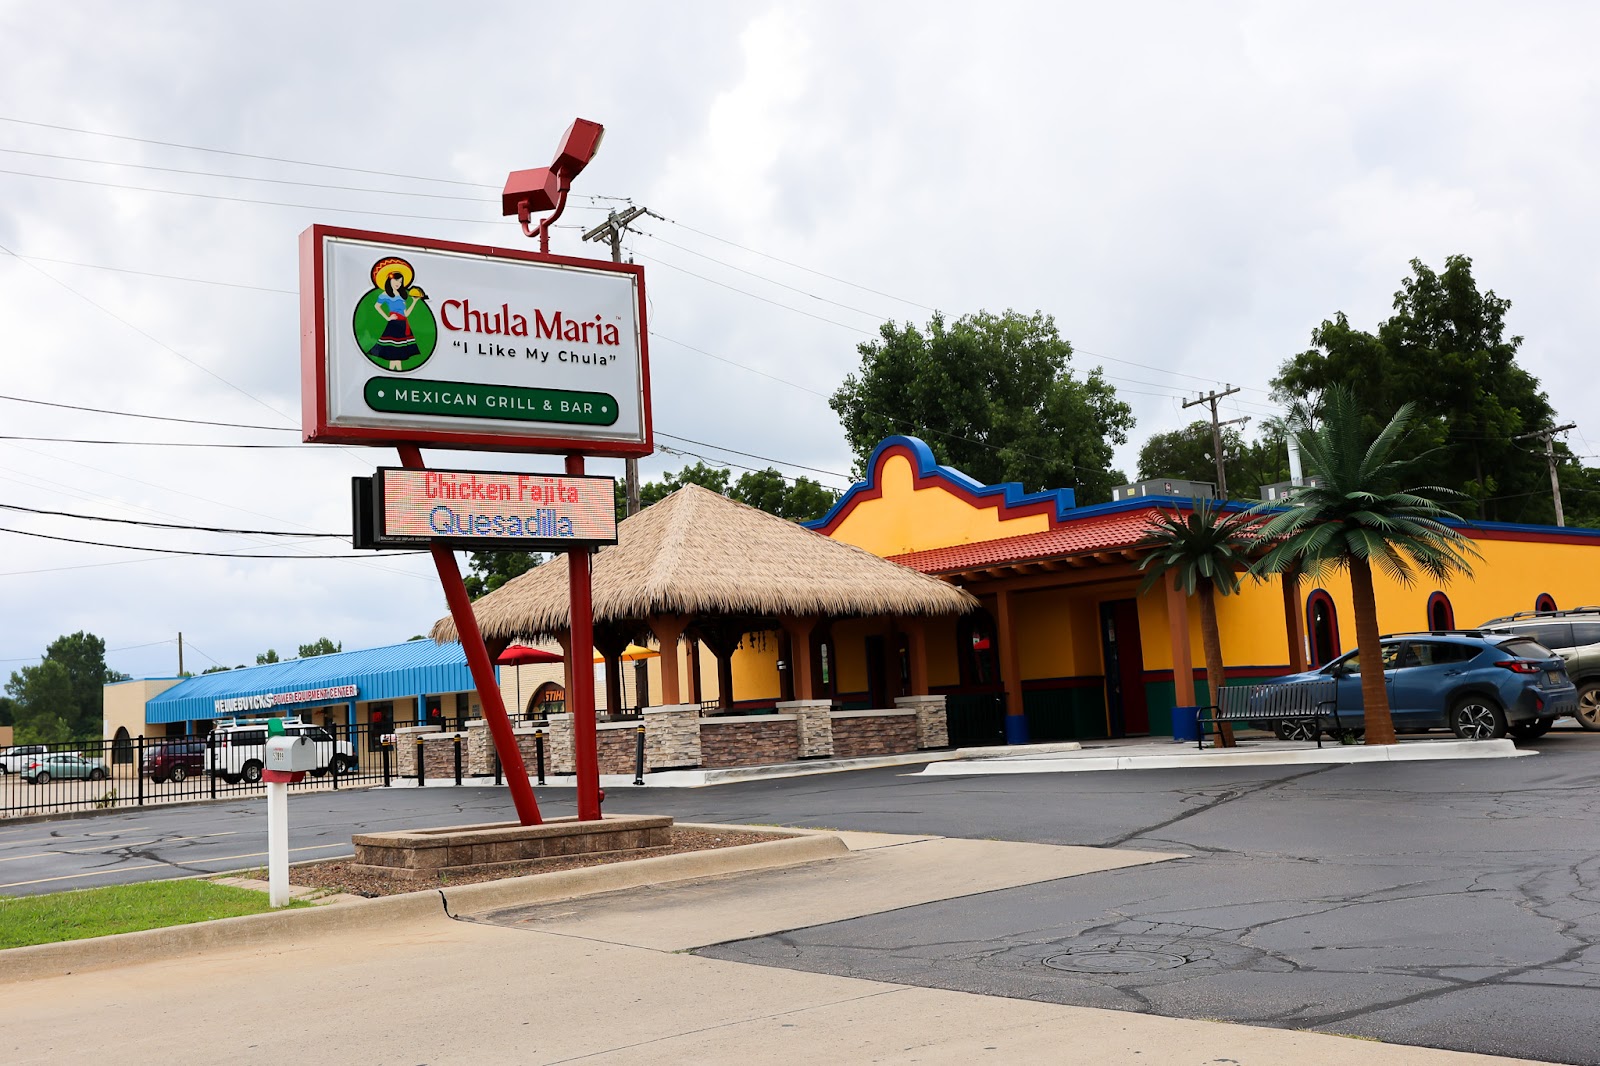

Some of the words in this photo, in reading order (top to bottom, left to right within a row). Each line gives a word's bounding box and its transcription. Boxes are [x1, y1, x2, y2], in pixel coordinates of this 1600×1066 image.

[440, 299, 528, 337] Chula
[534, 309, 621, 346] Maria
[478, 343, 517, 358] Like
[526, 347, 549, 363] My
[395, 389, 477, 406] MEXICAN
[486, 396, 536, 410] GRILL
[542, 399, 553, 411] &
[560, 401, 593, 414] BAR
[424, 472, 511, 501] Chicken
[518, 475, 579, 506] Fajita
[429, 505, 575, 537] Quesadilla
[273, 692, 293, 704] POWER
[294, 688, 328, 702] EQUIPMENT
[329, 686, 354, 698] CENTER
